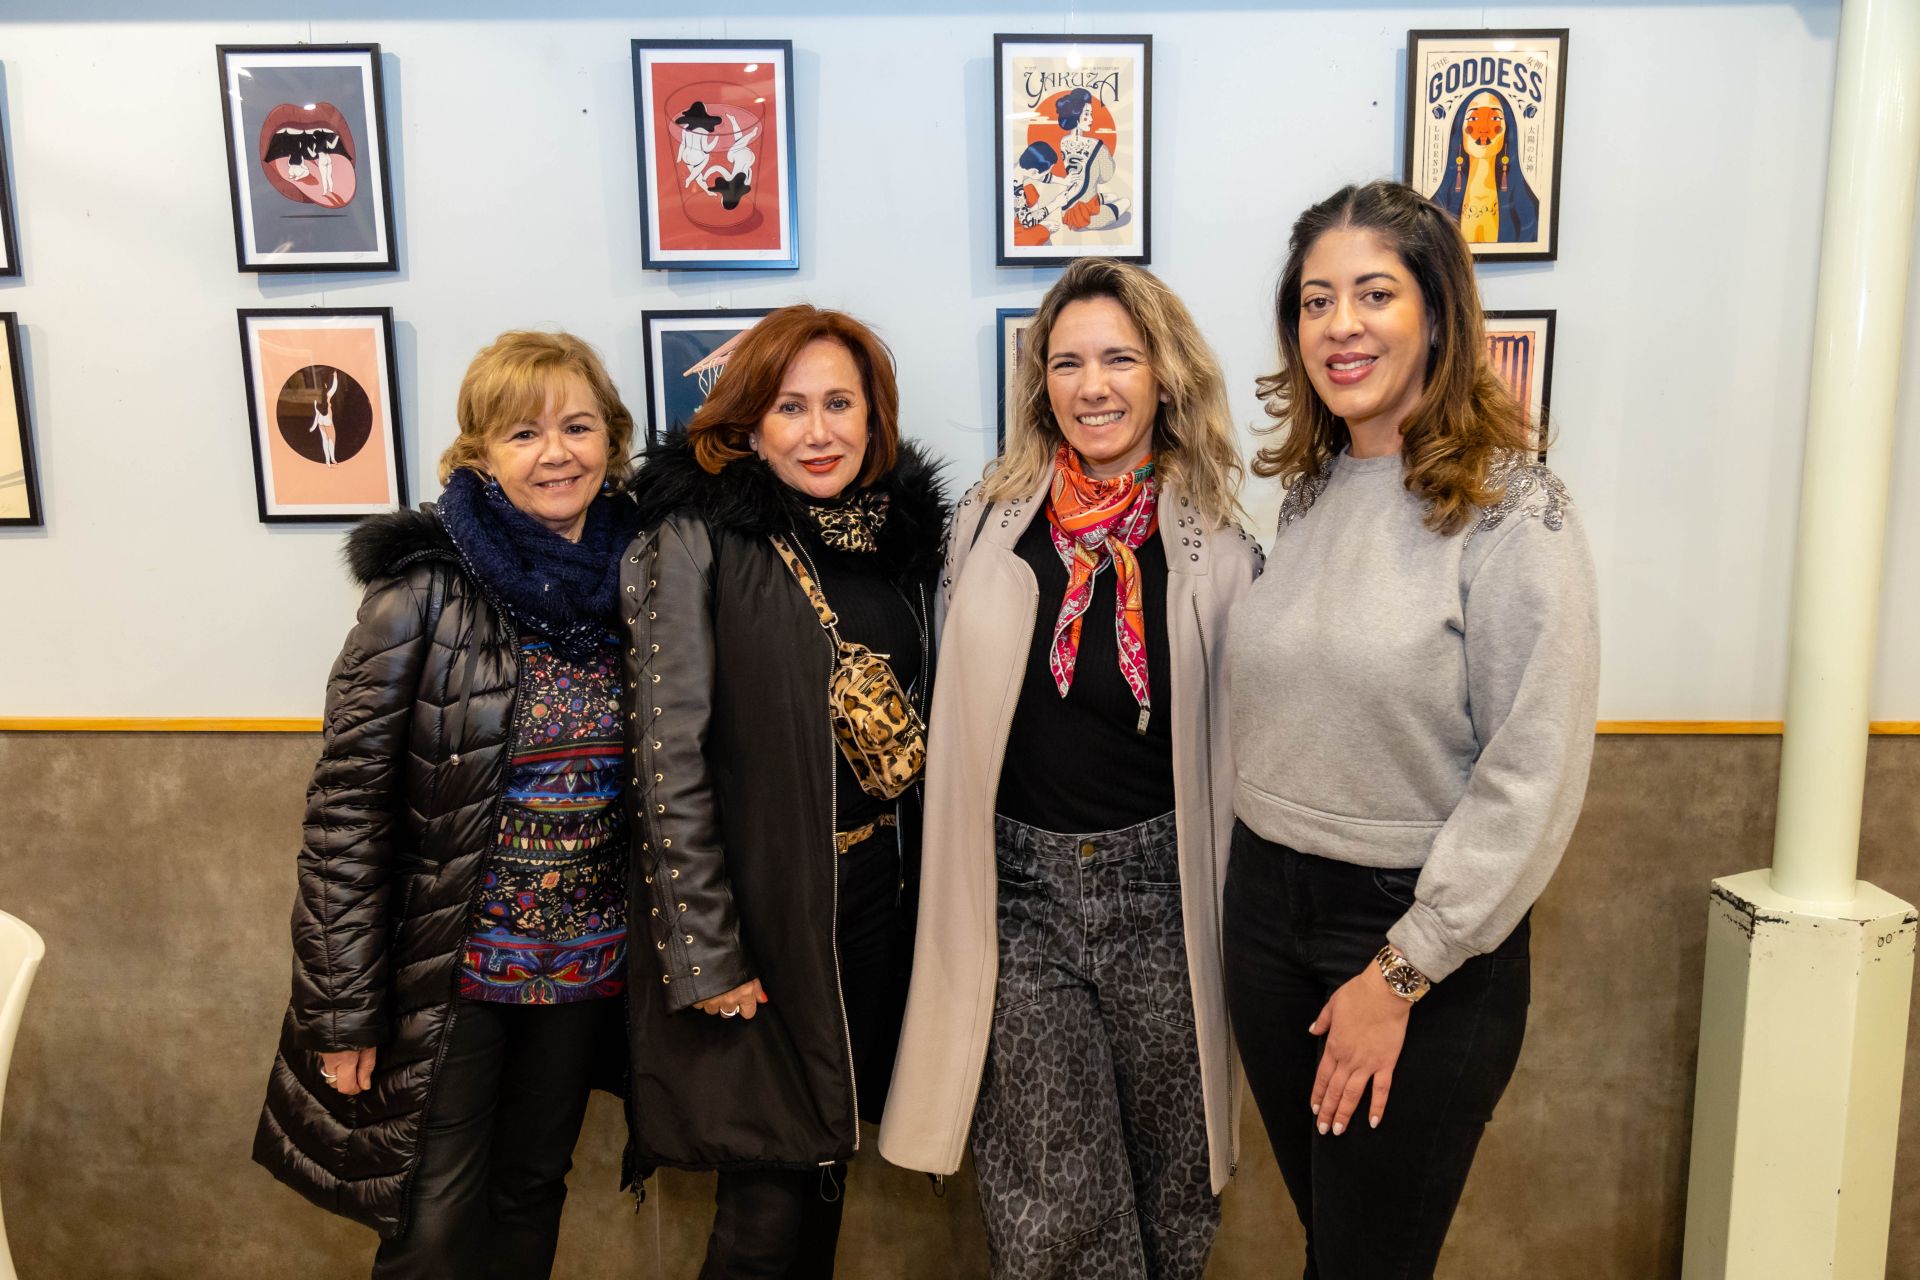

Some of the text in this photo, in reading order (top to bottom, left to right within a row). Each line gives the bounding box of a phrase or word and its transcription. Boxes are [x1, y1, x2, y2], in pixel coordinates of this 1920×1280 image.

[1429, 57, 1543, 104] GODDESS
[1431, 56, 1450, 71] THE
[1023, 71, 1120, 109] YAKUZA
